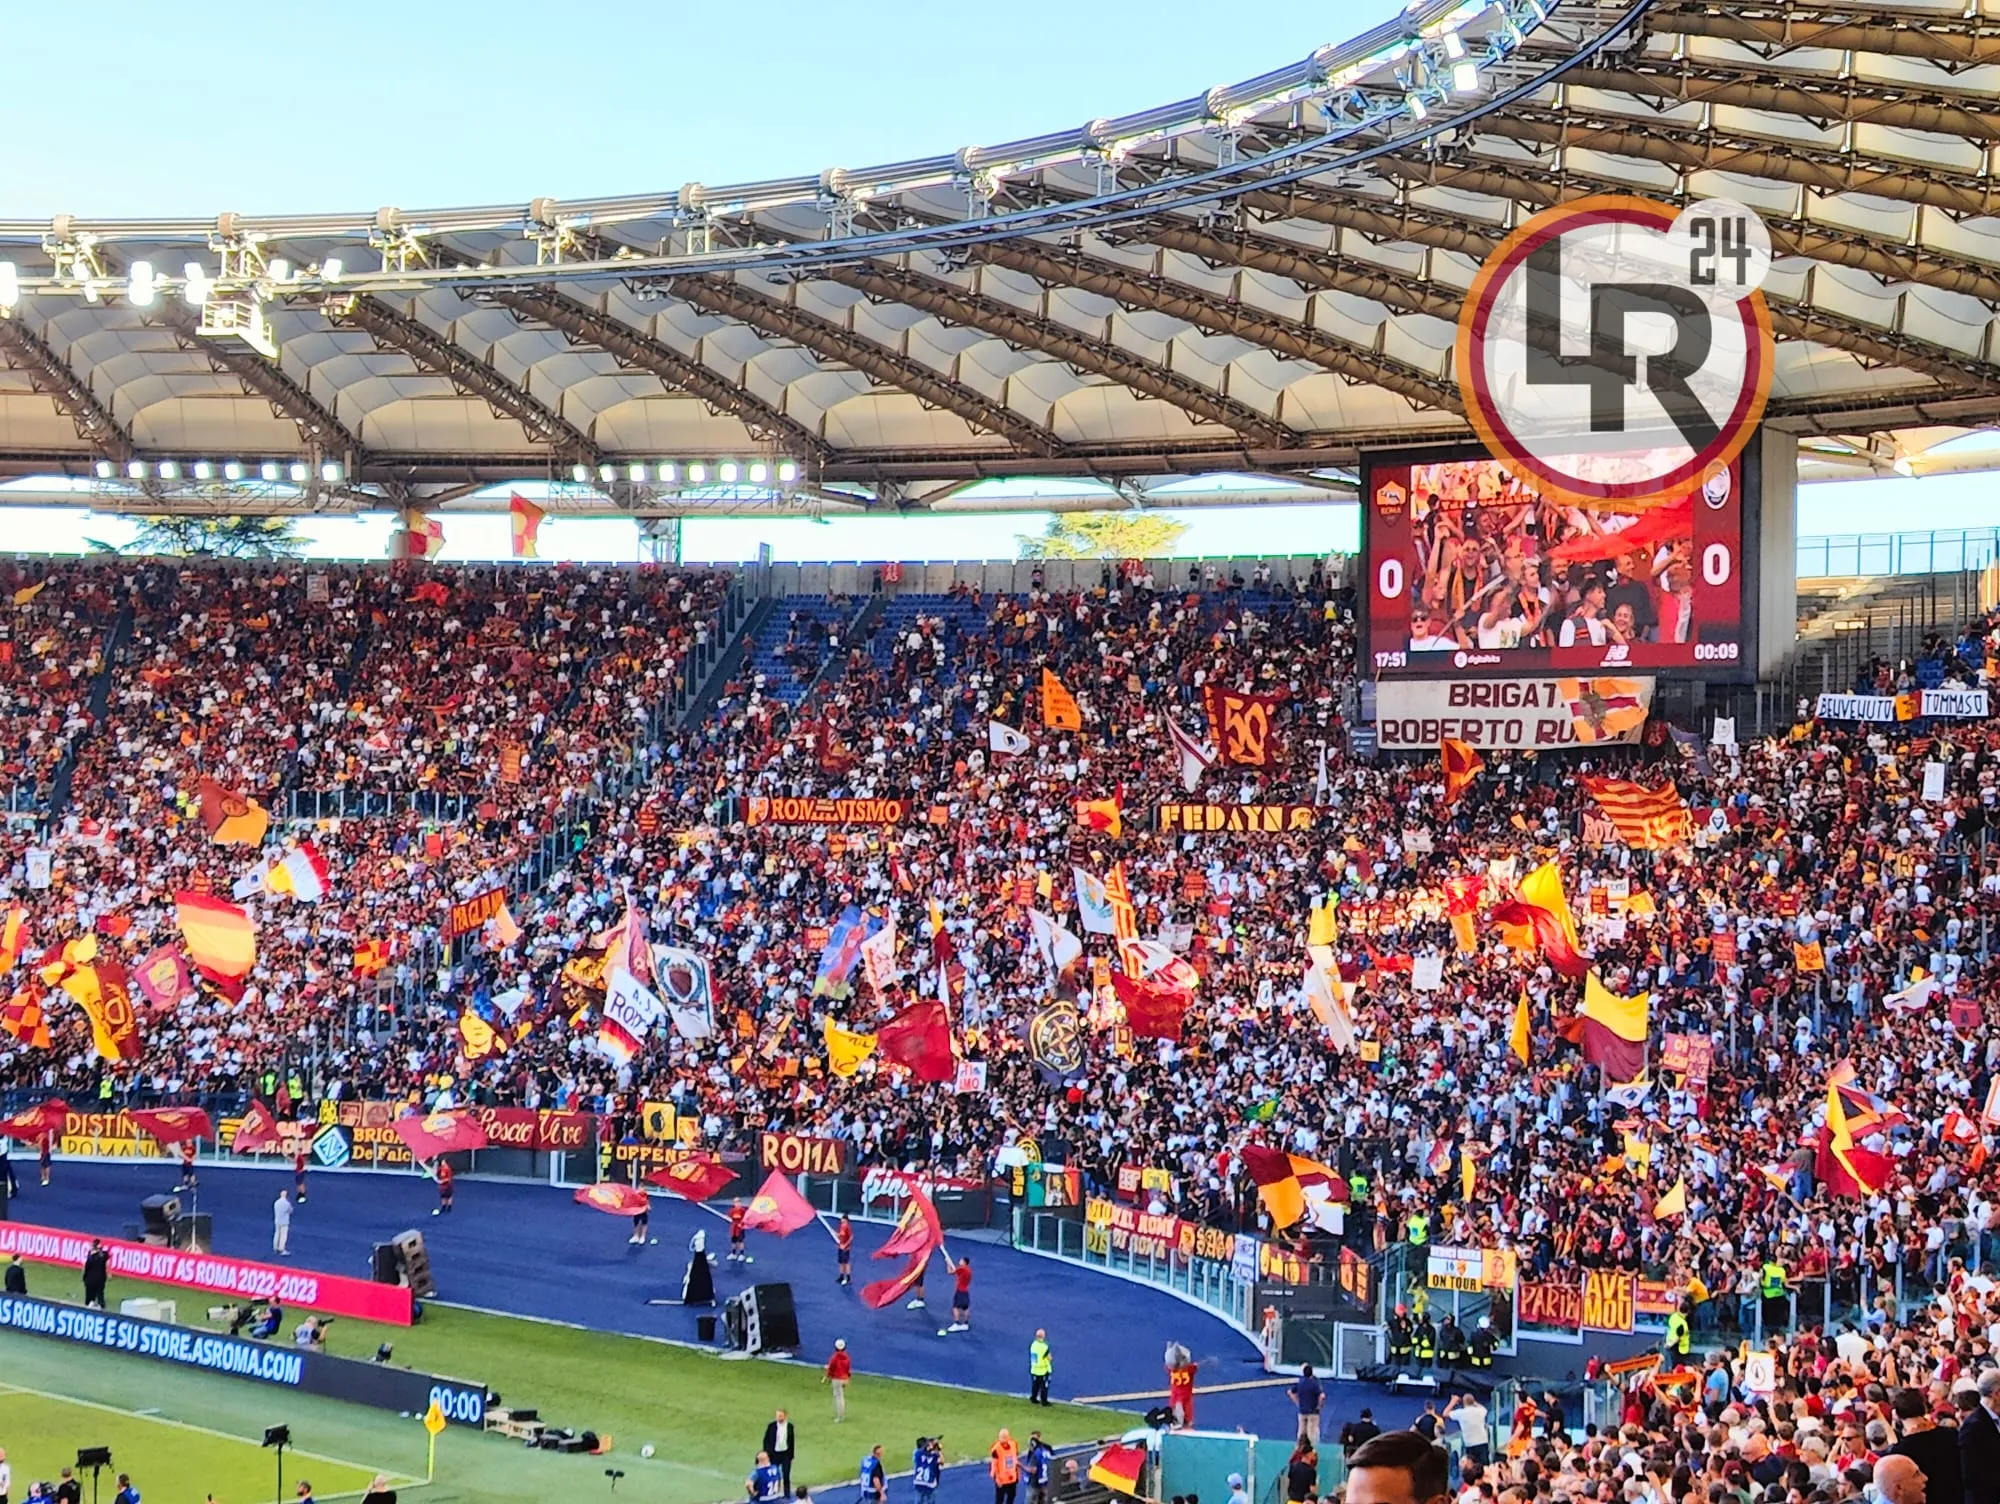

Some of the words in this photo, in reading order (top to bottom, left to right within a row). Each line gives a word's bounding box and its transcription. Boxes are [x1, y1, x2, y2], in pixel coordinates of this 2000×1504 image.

[1703, 543, 1730, 586] 0
[1380, 559, 1403, 599] 0
[1375, 652, 1407, 668] 17:51
[1694, 643, 1738, 660] 00:09
[1449, 683, 1566, 707] BRIGAT
[1925, 693, 1983, 714] TOMMASO
[1381, 719, 1522, 744] ROBERTO
[1161, 805, 1283, 833] FEDAYN
[65, 1112, 147, 1137] DISTIN
[352, 1127, 404, 1145] BRIGA
[352, 1146, 373, 1161] De
[378, 1147, 412, 1162] Falc
[763, 1135, 841, 1174] ROMA
[1, 1229, 16, 1251] LA
[17, 1231, 60, 1258] NUOVA
[110, 1246, 151, 1274] THIRD
[151, 1253, 176, 1279] KIT
[174, 1258, 195, 1282] AS
[195, 1262, 237, 1290] ROMA
[238, 1268, 319, 1304] 2022-2023
[1432, 1274, 1446, 1288] ON
[1450, 1276, 1476, 1291] TOUR
[1586, 1269, 1631, 1302] AVE
[1584, 1298, 1632, 1330] MOU
[12, 1301, 55, 1333] ROMA
[56, 1309, 105, 1343] STORE
[104, 1319, 117, 1345] E
[117, 1322, 140, 1350] SU
[139, 1325, 303, 1385] STORE.ASROMA.COM
[429, 1386, 481, 1422] 00:00
